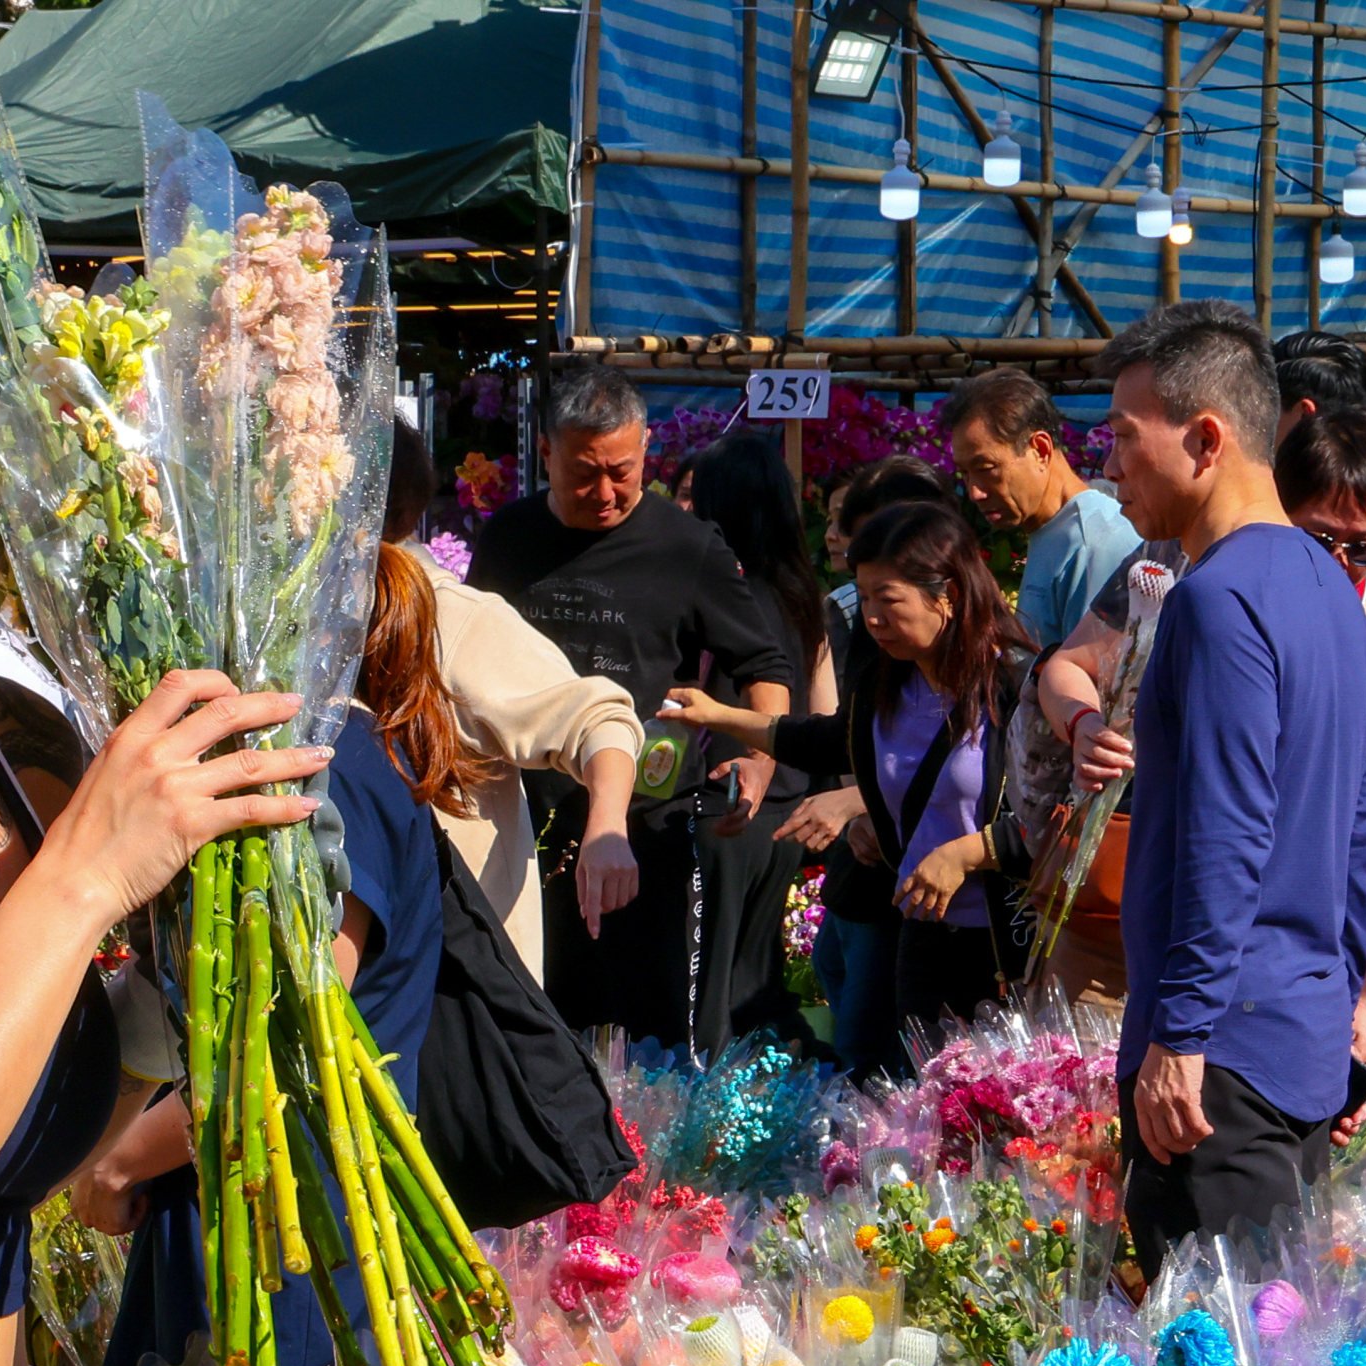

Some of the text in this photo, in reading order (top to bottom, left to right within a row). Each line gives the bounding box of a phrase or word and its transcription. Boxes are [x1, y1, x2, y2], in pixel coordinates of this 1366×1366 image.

[757, 376, 821, 412] 259
[517, 606, 626, 625] AUL&SHARK
[593, 655, 633, 673] Wind
